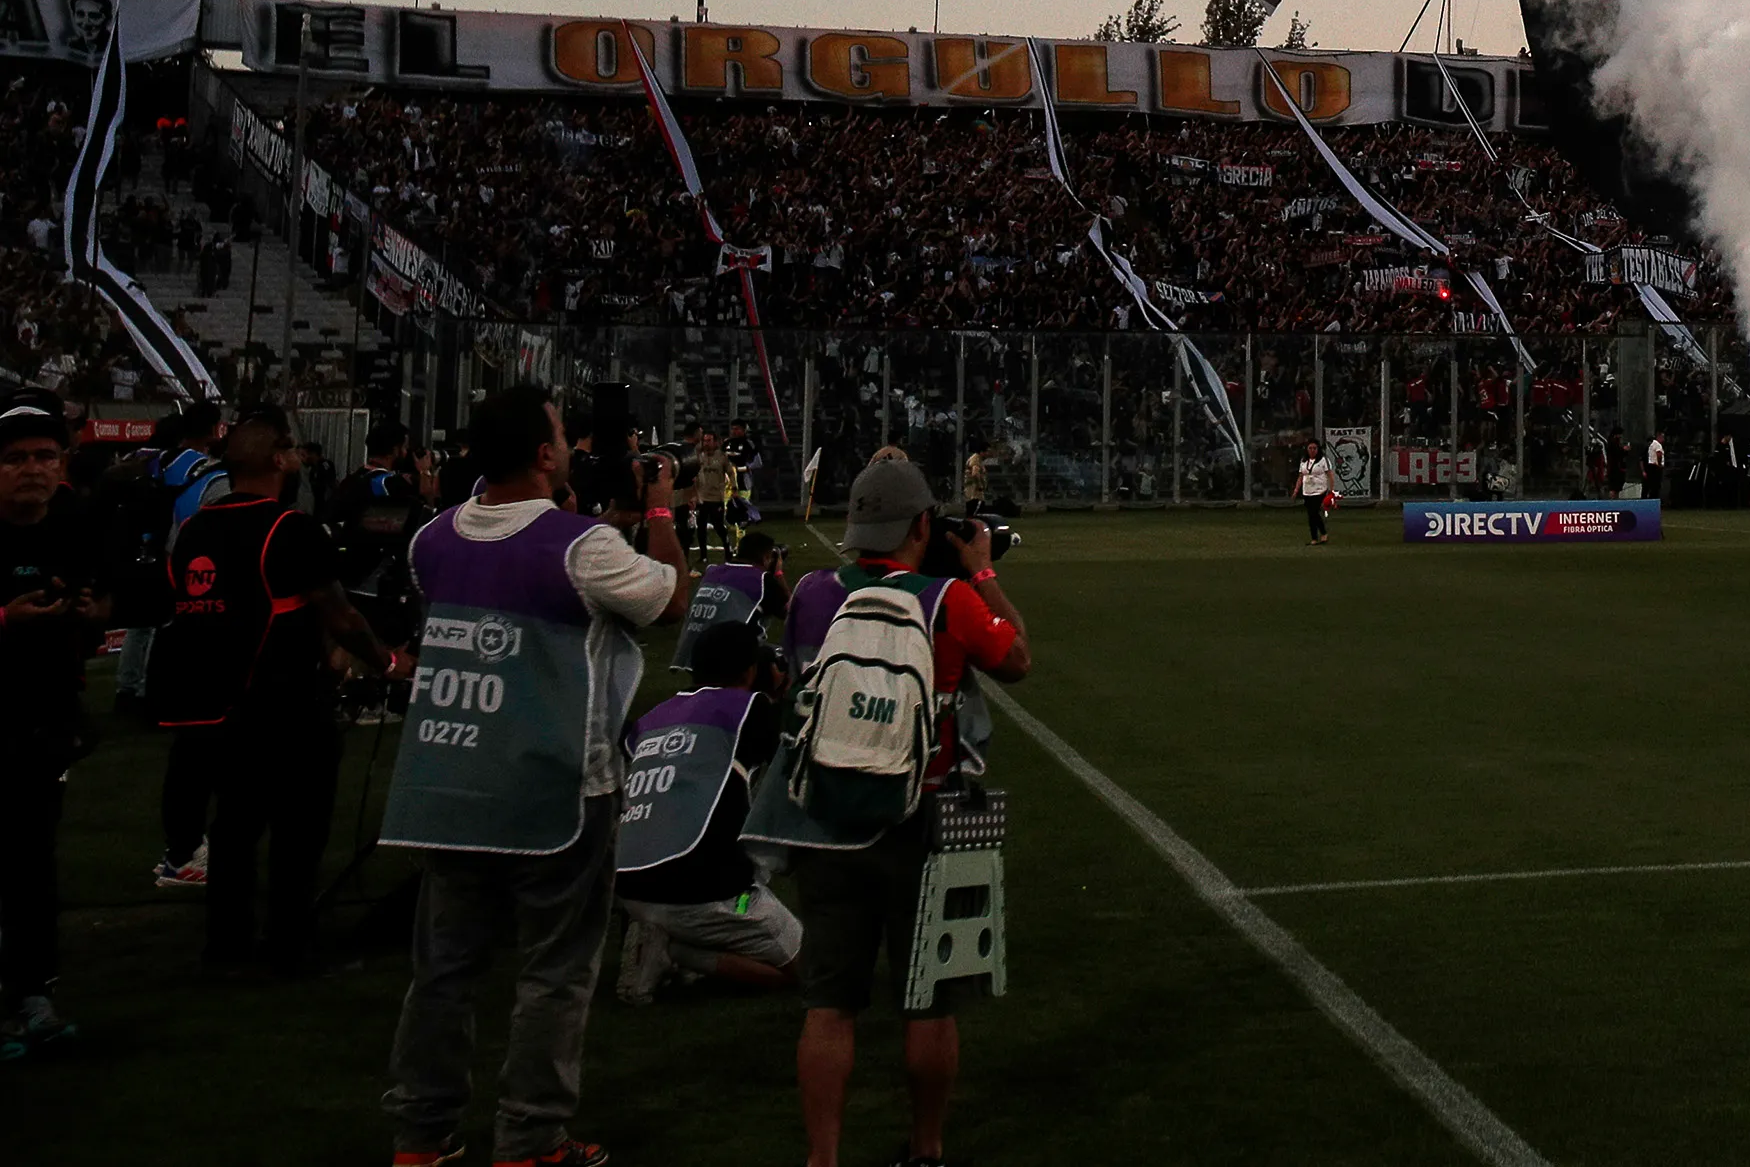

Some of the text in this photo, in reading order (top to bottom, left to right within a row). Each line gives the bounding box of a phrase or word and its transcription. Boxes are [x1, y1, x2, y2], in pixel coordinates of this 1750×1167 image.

[552, 20, 1352, 122] ORGULLO
[1424, 512, 1620, 537] DIRECTV INTERNET
[1563, 523, 1614, 534] FIBRA ÓPTICA
[187, 570, 216, 584] TNT
[409, 666, 505, 714] FOTO
[849, 691, 896, 725] SJM
[418, 718, 480, 748] 0272
